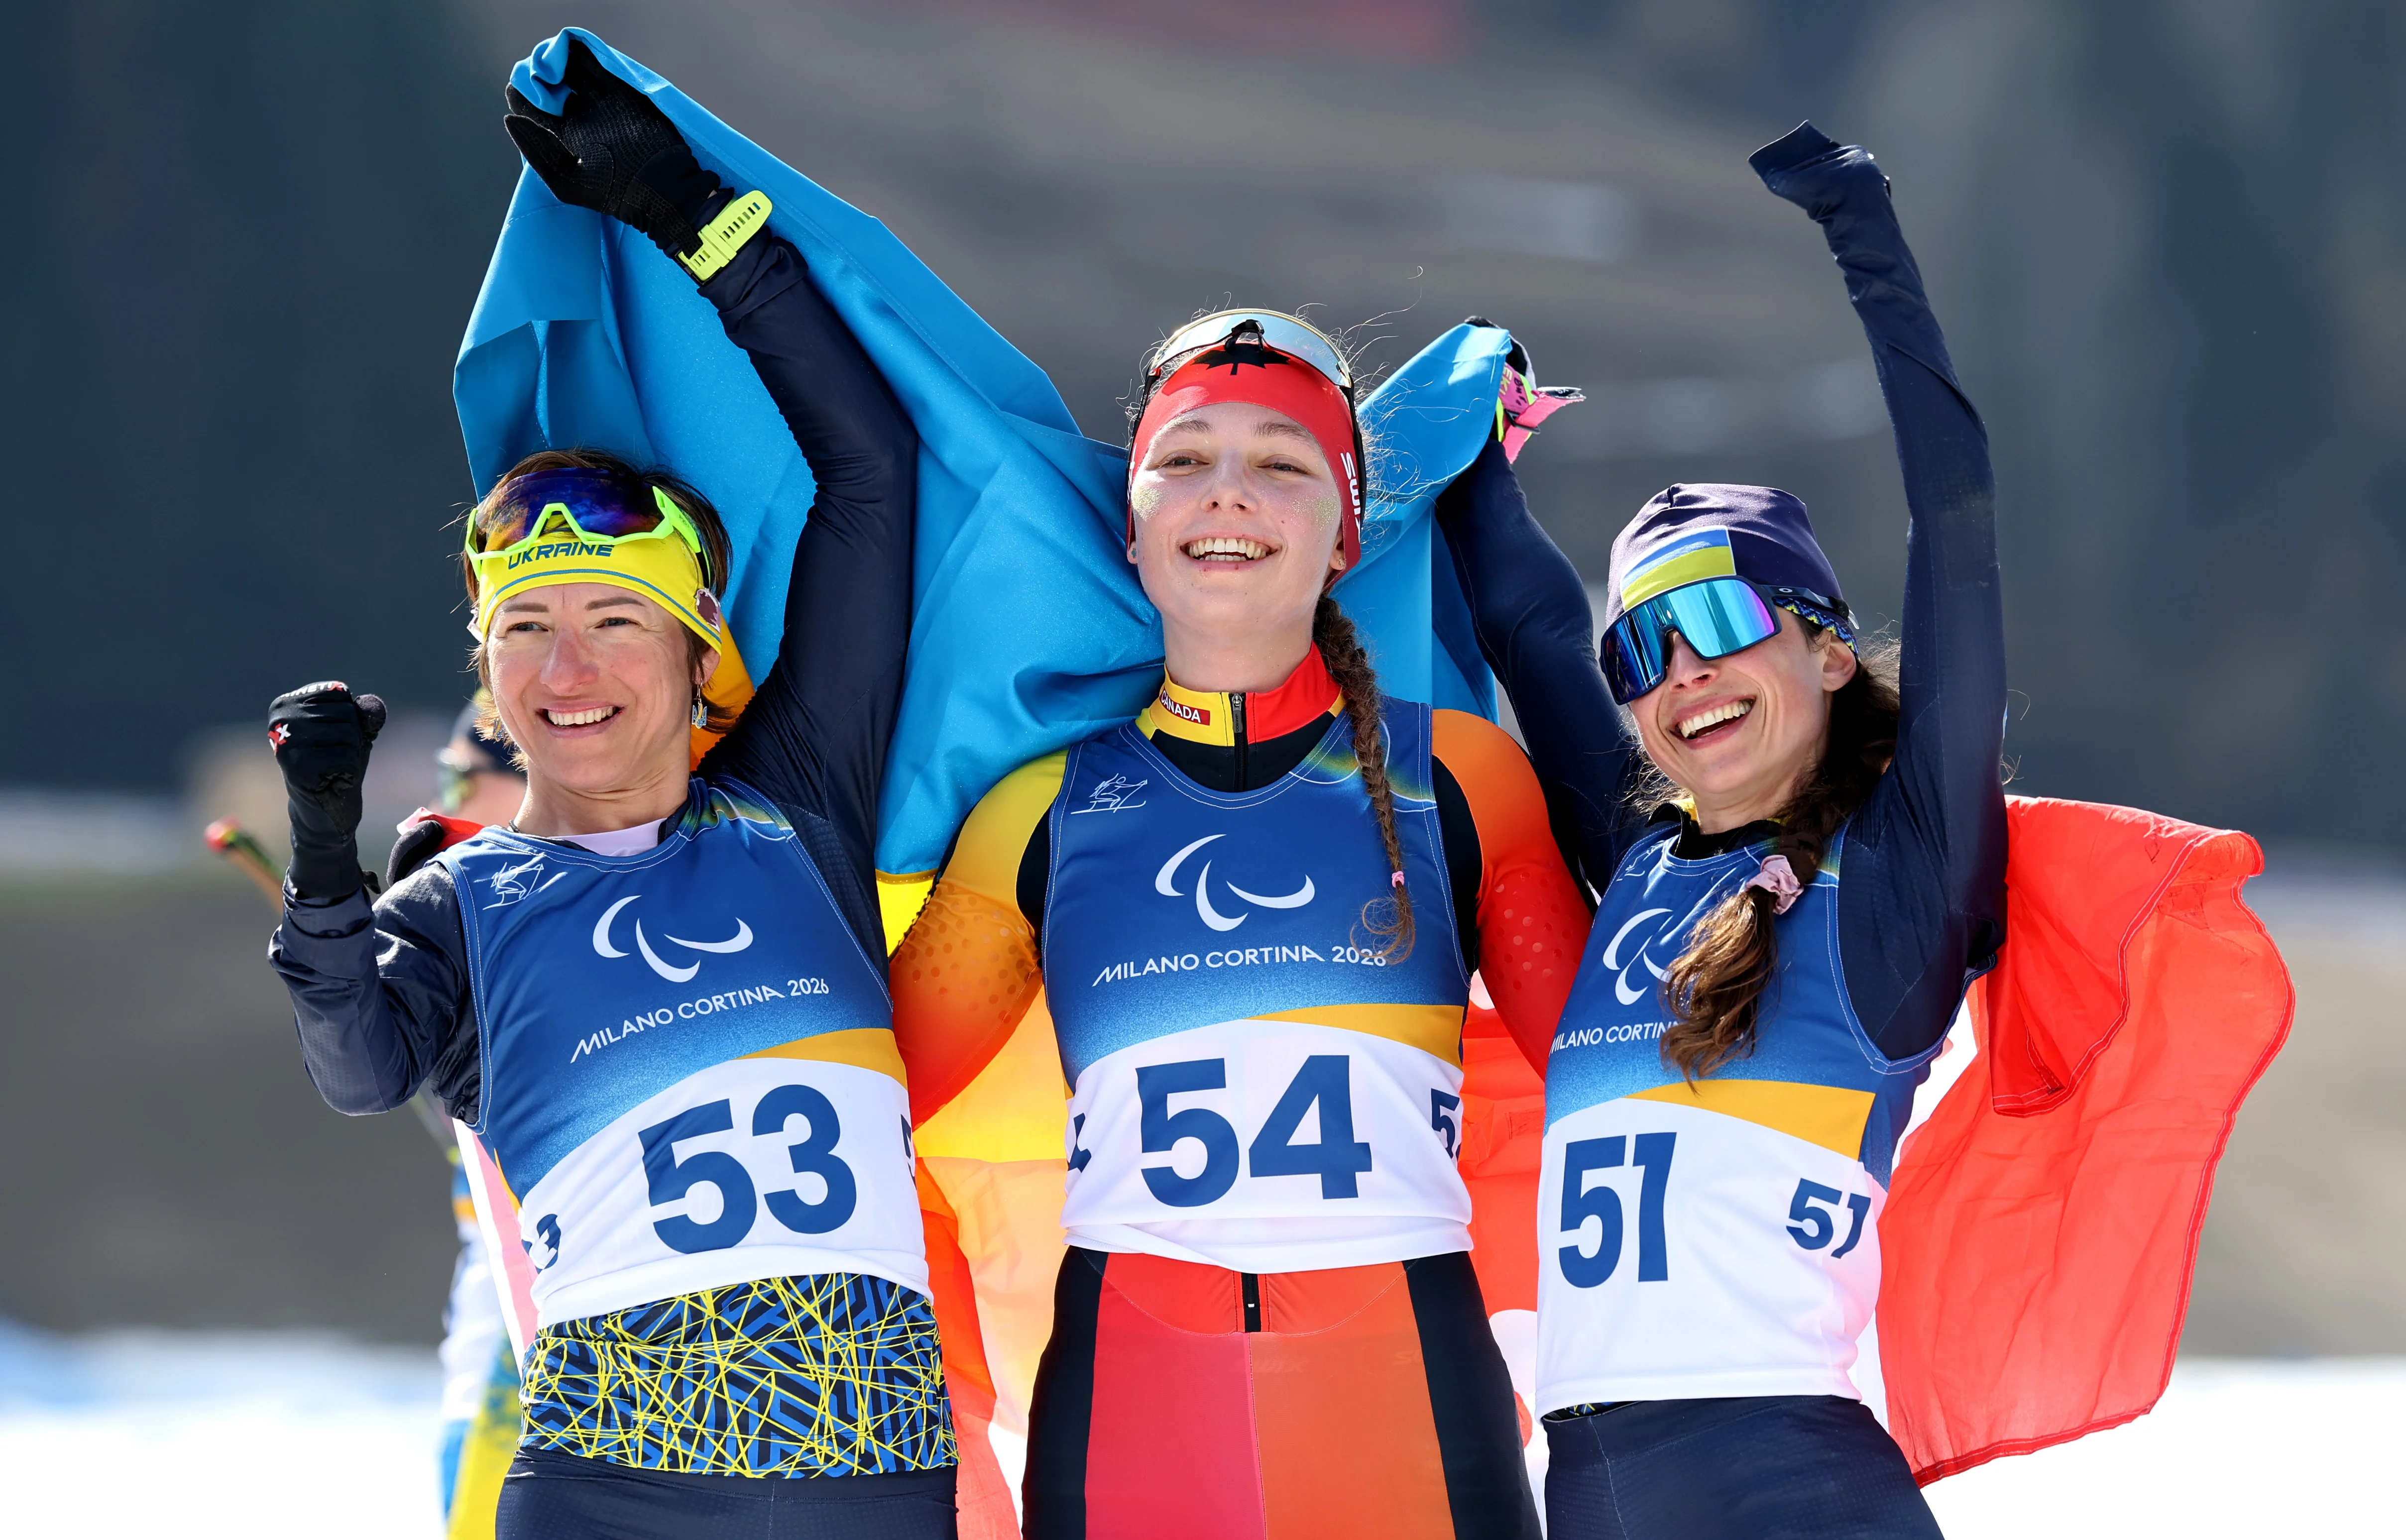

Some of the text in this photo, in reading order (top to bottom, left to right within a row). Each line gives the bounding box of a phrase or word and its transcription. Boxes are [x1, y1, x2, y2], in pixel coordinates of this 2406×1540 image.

[508, 542, 615, 570] UKRAINE
[1161, 690, 1201, 723] CANADA
[1092, 945, 1386, 987] MILANO CORTINA 2026
[570, 977, 829, 1064] MILANO CORTINA 2026
[1549, 1021, 1680, 1058] MILANO CORTIN
[1135, 1055, 1373, 1207] 54
[1431, 1088, 1462, 1161] 5
[638, 1084, 857, 1254] 53
[1559, 1132, 1677, 1288] 51
[1786, 1178, 1871, 1259] 51
